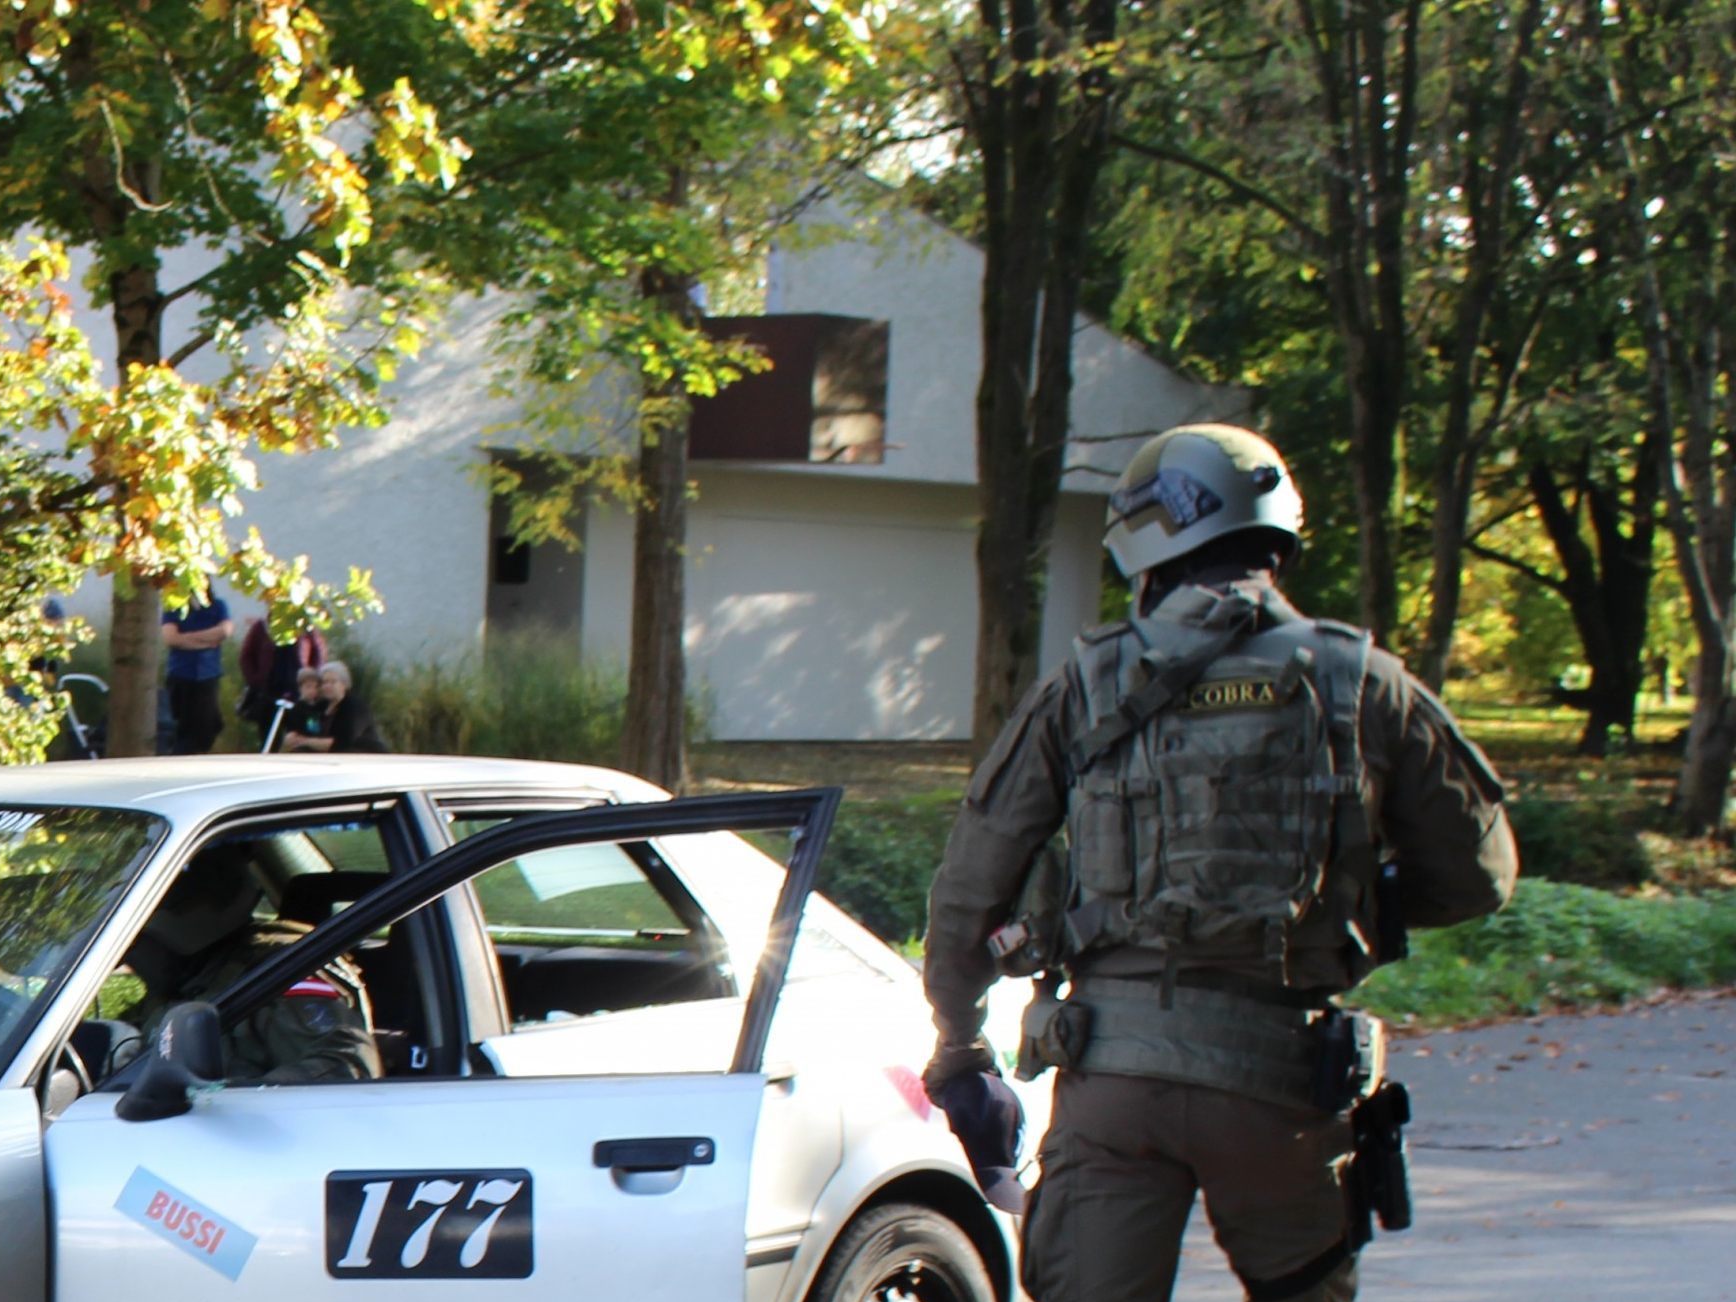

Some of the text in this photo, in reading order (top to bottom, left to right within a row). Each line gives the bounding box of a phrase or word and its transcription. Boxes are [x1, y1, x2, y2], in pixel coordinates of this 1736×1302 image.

[1190, 681, 1275, 709] COBRA
[145, 1188, 227, 1256] BUSSI
[336, 1179, 524, 1269] 177
